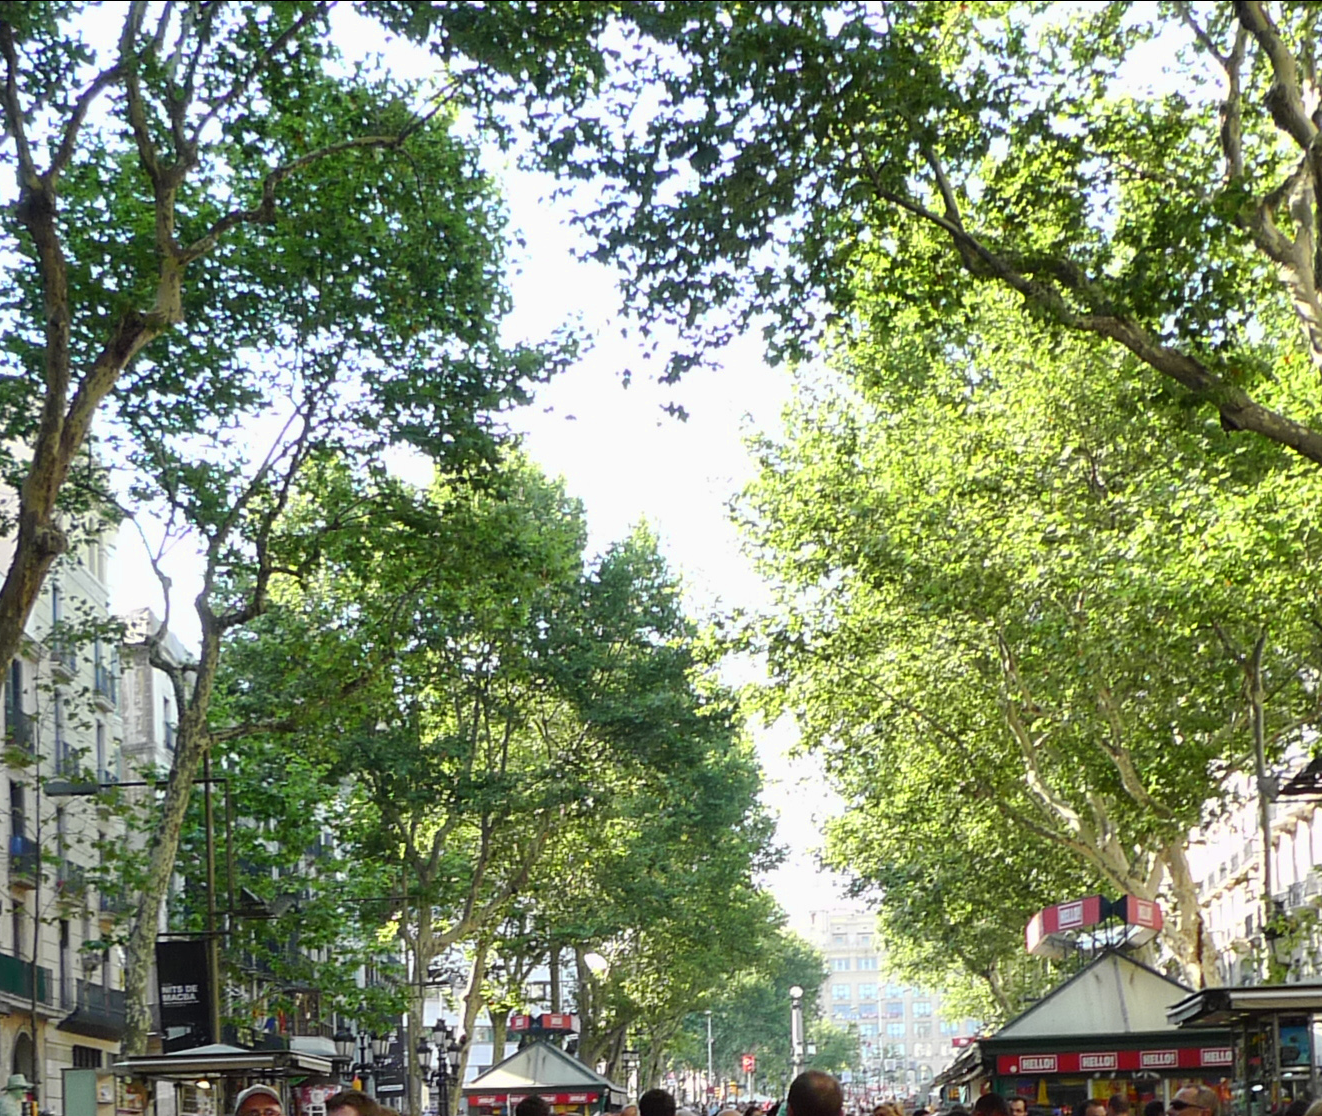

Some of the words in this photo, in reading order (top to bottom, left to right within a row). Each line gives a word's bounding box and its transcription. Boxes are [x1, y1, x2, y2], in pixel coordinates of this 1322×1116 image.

[1020, 1058, 1054, 1070] HELLO!
[1082, 1055, 1115, 1068] HELLO!
[1142, 1053, 1175, 1065] HELLO!
